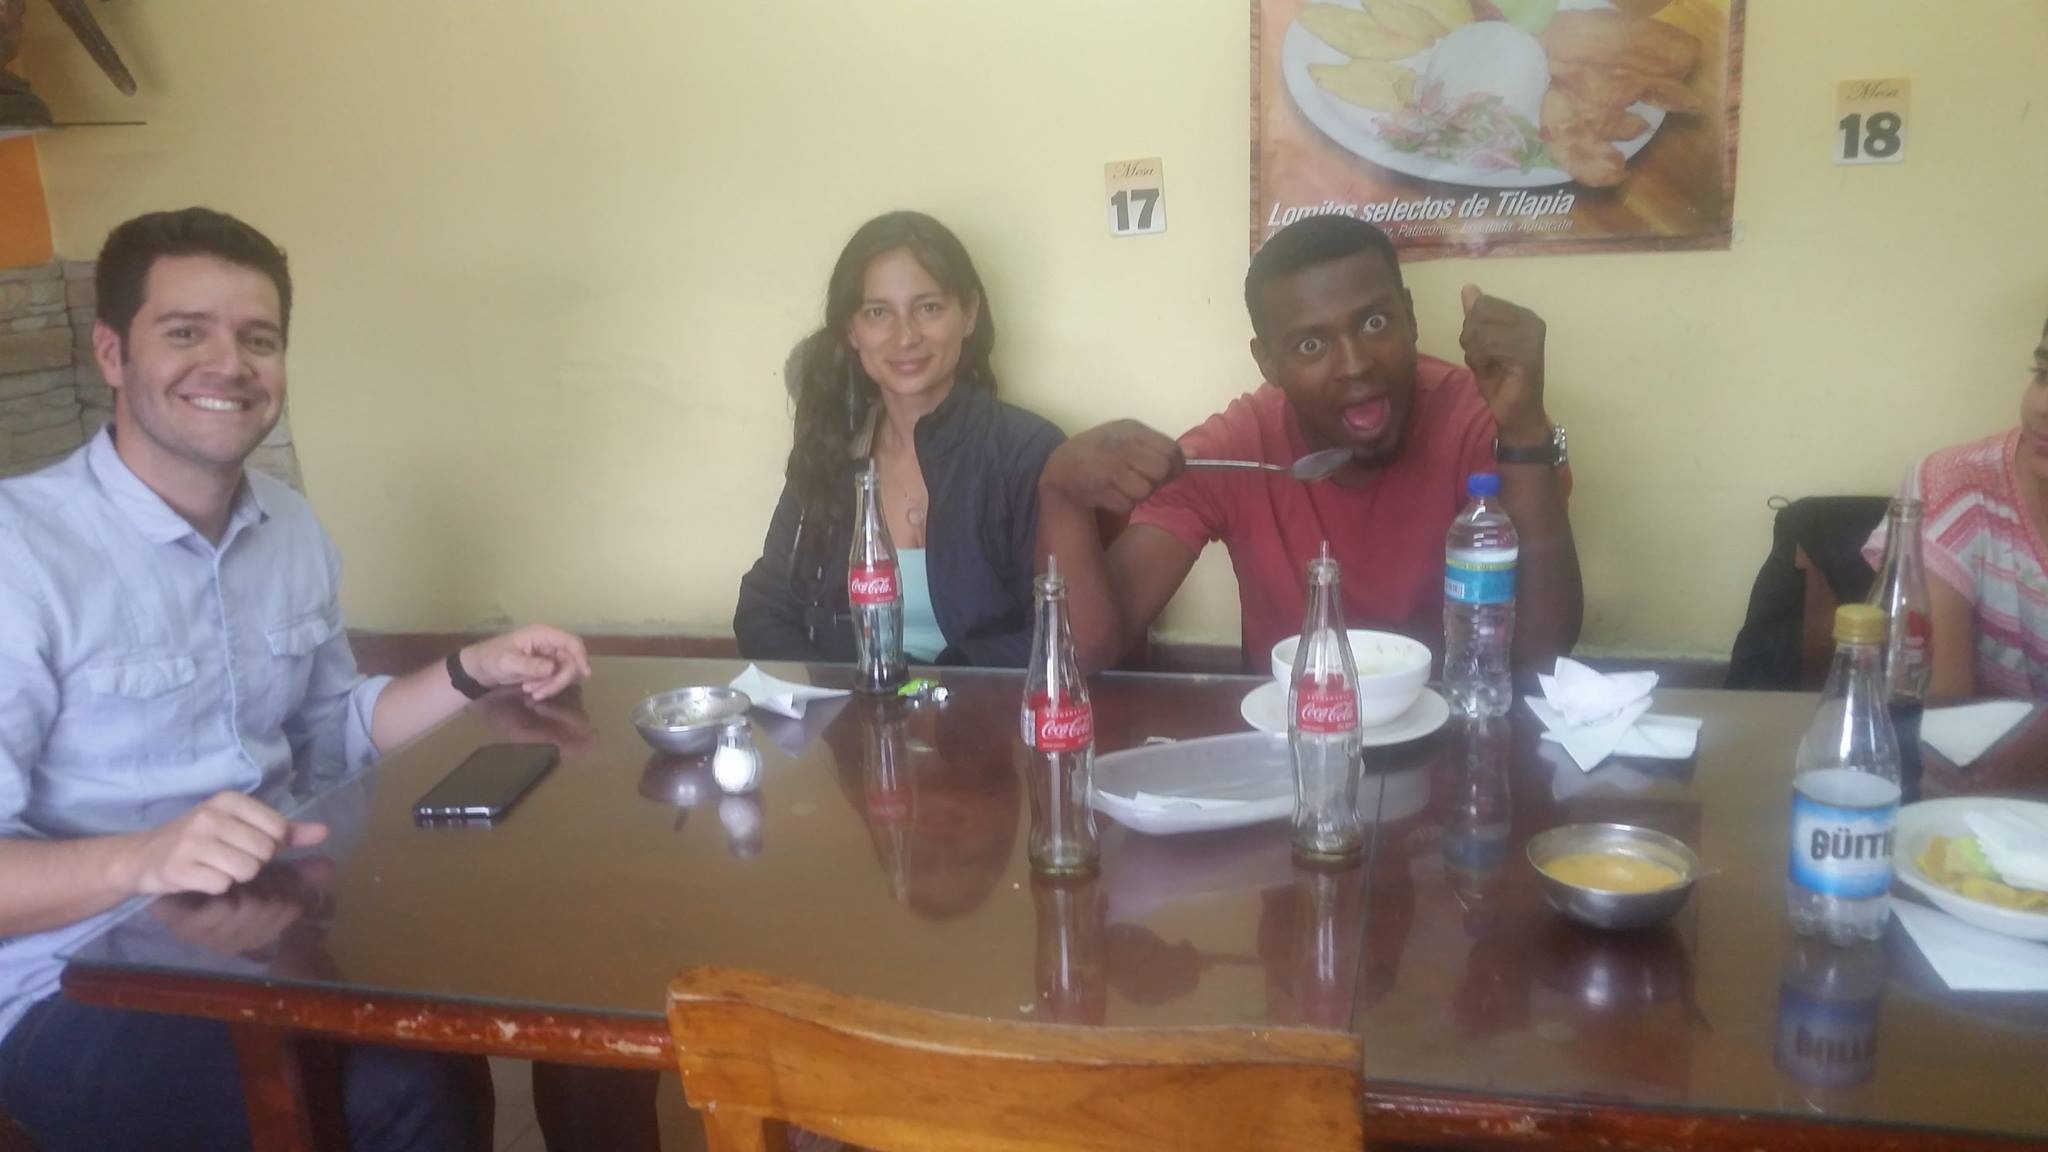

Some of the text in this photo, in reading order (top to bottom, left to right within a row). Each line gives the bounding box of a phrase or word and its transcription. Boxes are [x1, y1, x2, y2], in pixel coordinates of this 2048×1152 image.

[1844, 82, 1900, 100] Mesa
[1840, 112, 1902, 159] 18
[1112, 161, 1155, 178] Mesa
[1111, 188, 1160, 231] 17
[1360, 196, 1455, 222] selectos
[1458, 192, 1490, 218] de
[1496, 189, 1575, 220] Tilapia
